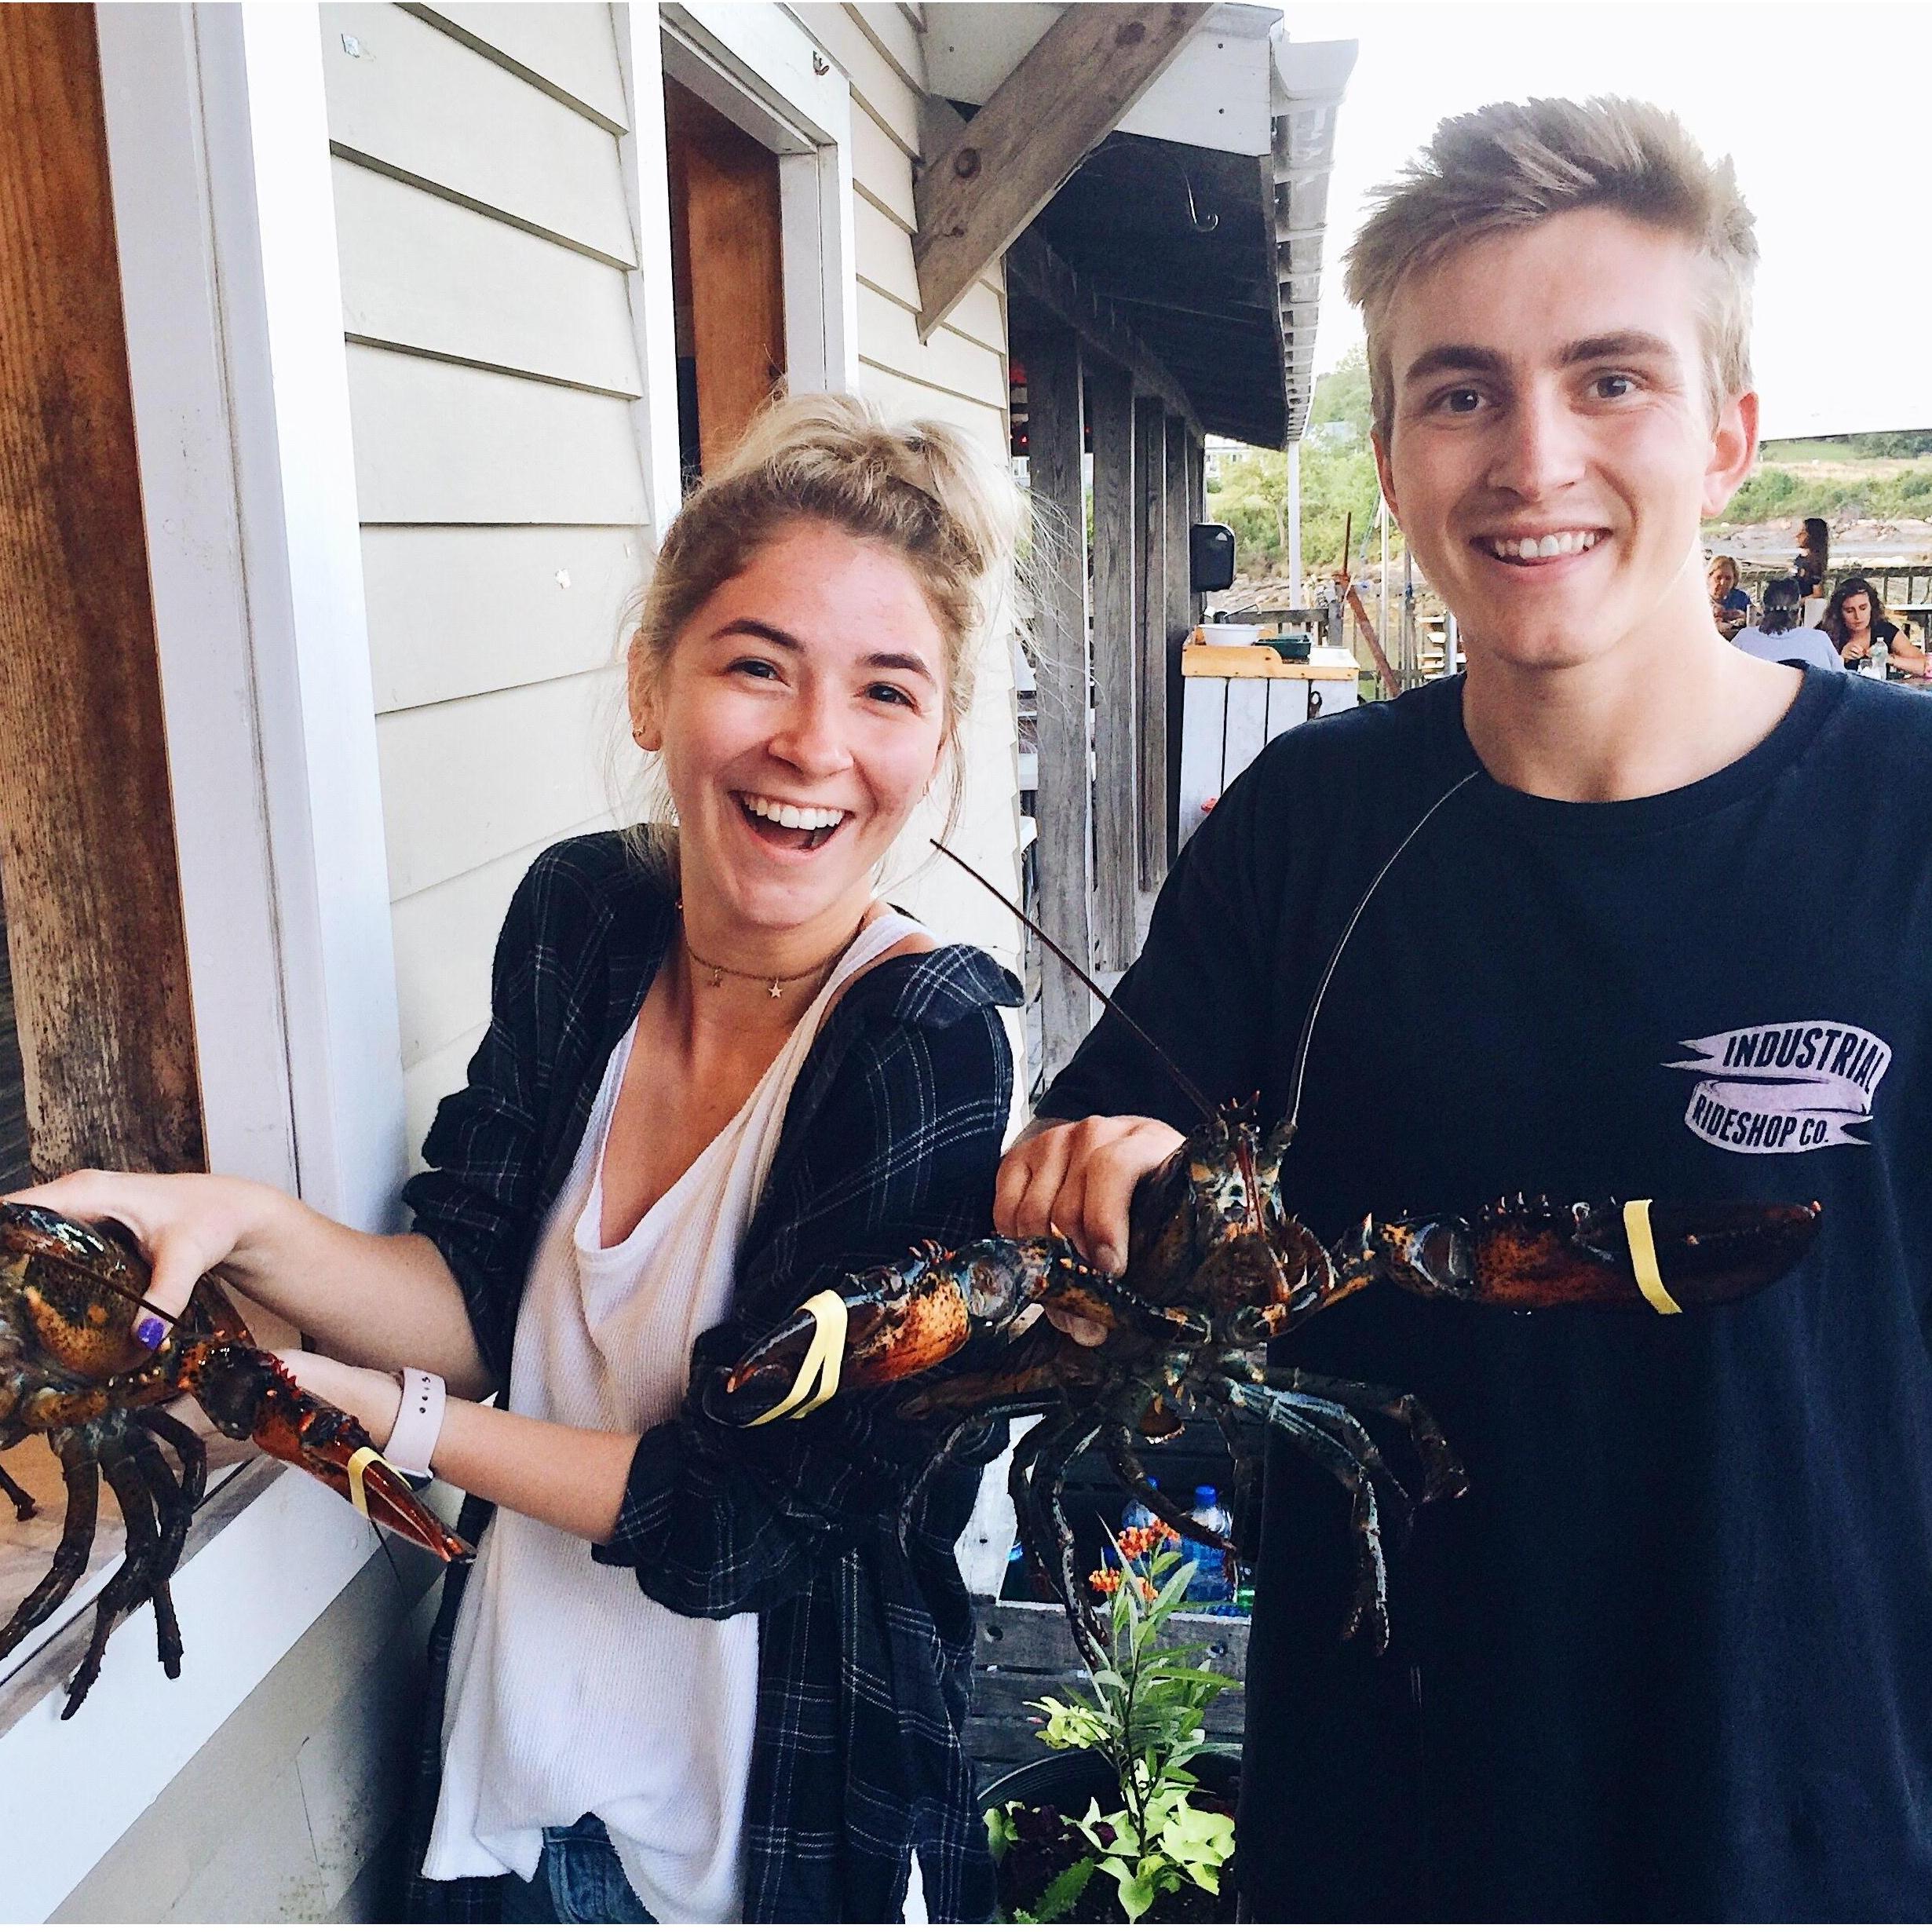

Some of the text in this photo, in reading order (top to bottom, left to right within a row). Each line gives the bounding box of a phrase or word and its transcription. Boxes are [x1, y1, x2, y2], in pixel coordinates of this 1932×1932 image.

[1722, 1027, 1884, 1094] INDUSTRIAL
[1692, 1094, 1829, 1148] RIDESHOP CO.
